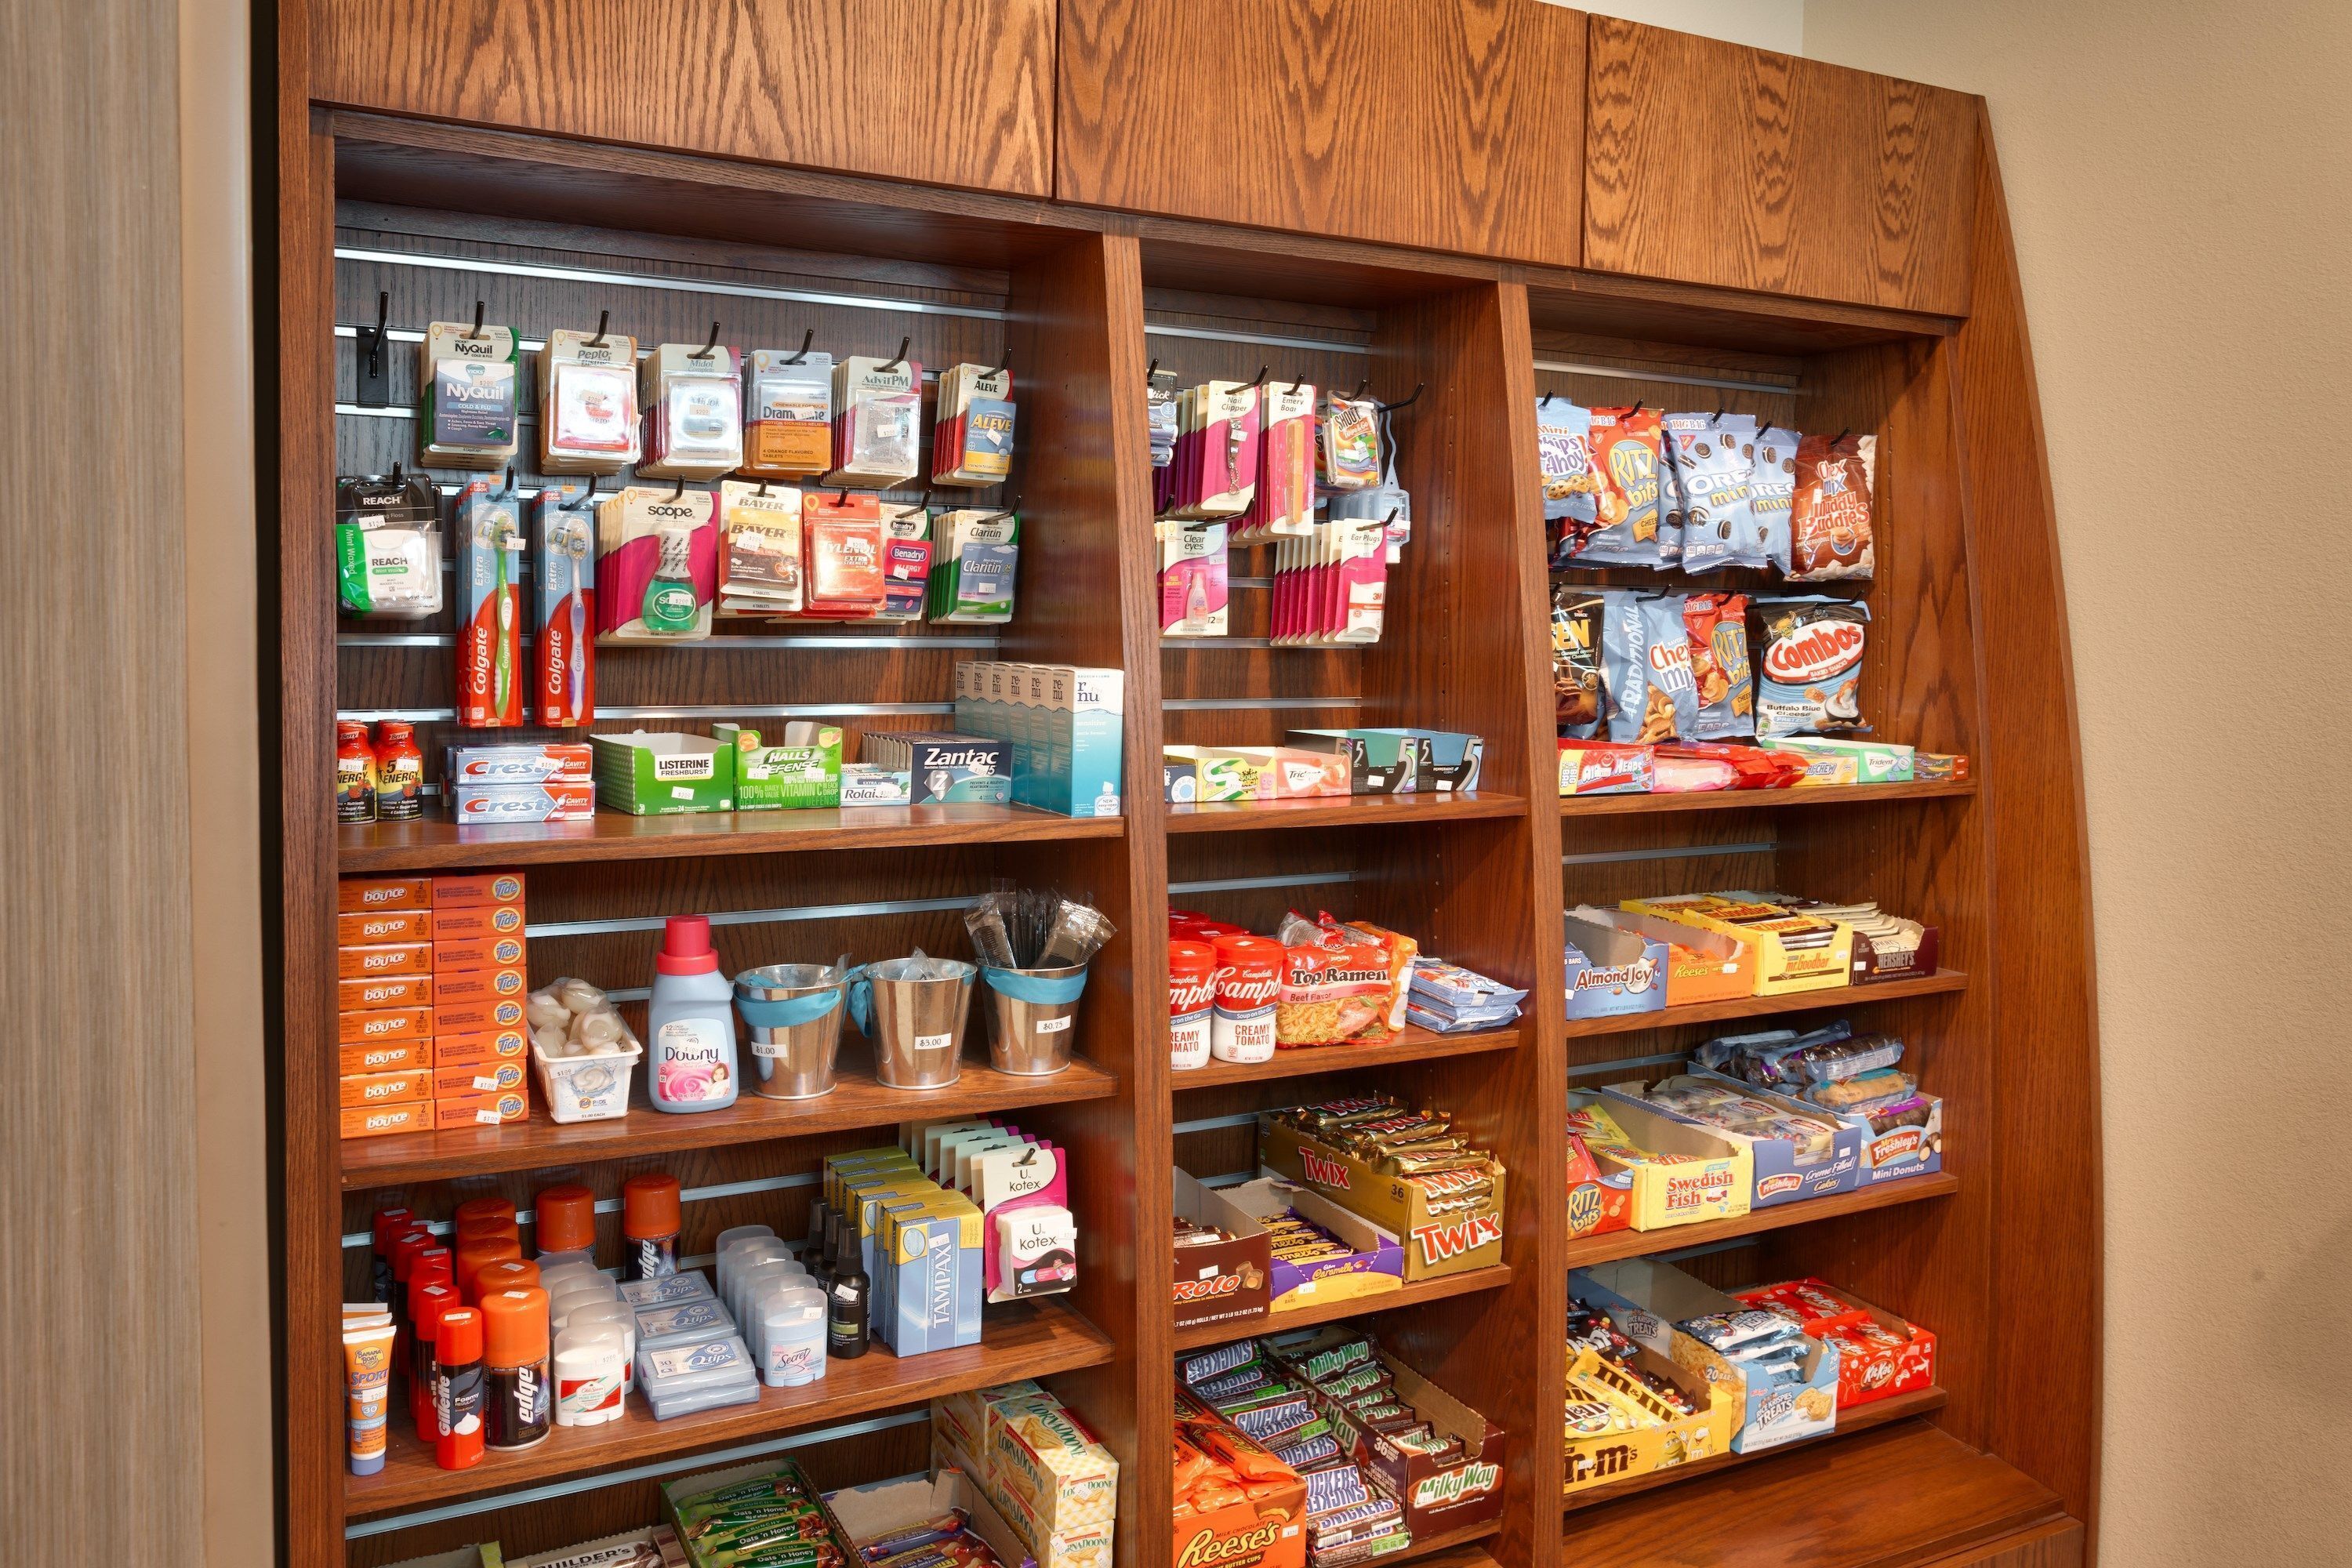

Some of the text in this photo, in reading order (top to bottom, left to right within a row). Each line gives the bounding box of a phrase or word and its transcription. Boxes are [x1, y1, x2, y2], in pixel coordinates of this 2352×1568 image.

[455, 343, 492, 355] NyQuil
[690, 359, 713, 368] Midol
[446, 383, 504, 401] NyQuil
[974, 380, 999, 393] ALEVE
[970, 414, 1012, 433] ALEVE
[1671, 419, 1706, 430] BIG BAG
[1545, 449, 1585, 474] Ahoy
[1611, 449, 1657, 491] RITZ
[1817, 459, 1848, 481] Chex
[1824, 474, 1848, 496] mix
[363, 496, 401, 506] REACH
[1627, 481, 1659, 508] bits
[739, 499, 784, 510] BAYER
[648, 506, 692, 519] scope
[1798, 503, 1870, 541] Buddies
[731, 524, 786, 539] BAYER
[970, 527, 1001, 538] Claritin
[1183, 535, 1205, 543] Clear
[1363, 535, 1381, 543] Plugs
[345, 529, 358, 575] Mint Waxed
[894, 548, 925, 560] Benadryl
[1184, 543, 1204, 552] eyes
[372, 557, 408, 566] REACH
[963, 560, 1001, 574] Claritin
[474, 555, 484, 586] Extra
[548, 561, 557, 591] Extra
[1771, 625, 1862, 671] Combos
[473, 626, 488, 695] Colgate
[548, 628, 562, 695] Colgate
[1077, 691, 1099, 702] nu
[768, 750, 811, 764] HALLS
[924, 747, 1000, 766] Zantac
[659, 759, 710, 770] LISTERINE
[1392, 737, 1415, 794] 5
[1456, 737, 1483, 792] 5
[1806, 763, 1838, 776] HI-CHEW
[384, 771, 419, 784] ENERGY
[661, 768, 708, 777] FRESHBURST
[739, 785, 764, 800] 100%
[781, 782, 822, 798] VITAMIN C
[464, 798, 556, 813] Crest
[810, 795, 839, 806] DEFENSE
[363, 887, 406, 902] bounce
[495, 884, 519, 897] Tide
[363, 920, 406, 935] bounce
[495, 913, 518, 927] Tide
[363, 953, 406, 967] bounce
[495, 946, 519, 959] Tide
[1878, 950, 1916, 969] HERSHEY'S
[1293, 967, 1388, 985] Top Ramen
[1575, 967, 1652, 989] Almond Joy
[1674, 964, 1709, 979] Reese's
[496, 976, 519, 989] Tide
[364, 985, 407, 1000] bounce
[1310, 992, 1332, 1001] Flavor
[497, 1007, 520, 1021] Tide
[364, 1018, 407, 1033] bounce
[1042, 1020, 1064, 1031] $0.75
[1235, 1024, 1270, 1036] CREAMY
[497, 1037, 520, 1051] Tide
[919, 1037, 942, 1048] $3.00
[1235, 1034, 1270, 1047] TOMATO
[365, 1050, 407, 1064] bounce
[665, 1047, 720, 1068] Downy
[756, 1046, 776, 1055] $1.00
[497, 1069, 520, 1083] Tide
[365, 1082, 407, 1097] bounce
[499, 1098, 523, 1114] Tide
[366, 1112, 408, 1128] bounce
[1873, 1134, 1919, 1159] Freshley's
[1805, 1155, 1857, 1181] Creme Filled
[1871, 1163, 1925, 1181] Mini Donuts
[1666, 1171, 1735, 1192] Swedish
[1762, 1177, 1798, 1192] Freshley's
[1813, 1178, 1841, 1192] Cakes
[1390, 1184, 1403, 1198] 36
[1390, 1196, 1403, 1204] COUNT
[1568, 1185, 1602, 1219] RITZ
[1666, 1190, 1703, 1210] Fish
[1570, 1210, 1600, 1230] bits
[1312, 1265, 1354, 1280] Caramello
[933, 1244, 953, 1330] TAMPAX
[1017, 1283, 1022, 1294] 2
[675, 1313, 714, 1327] Q-tips
[1627, 1322, 1657, 1337] TREATS
[358, 1348, 382, 1359] BANANA
[361, 1356, 378, 1365] BOAT
[690, 1354, 733, 1367] Q-tips
[778, 1348, 811, 1368] Secret
[1308, 1341, 1369, 1380] Milky Way
[1186, 1341, 1252, 1382] SNICKERS
[351, 1368, 389, 1386] SPORT
[1706, 1367, 1734, 1381] 20 BARS
[454, 1392, 480, 1403] Foamy
[514, 1366, 539, 1424] edge
[364, 1405, 378, 1414] 30
[438, 1375, 451, 1436] Gillette
[1756, 1392, 1794, 1417] RICE KRISPIES
[1756, 1399, 1794, 1431] TREATS
[1373, 1437, 1388, 1456] 36
[1087, 1480, 1113, 1490] DOONE
[1414, 1470, 1465, 1508] Milky
[1463, 1462, 1499, 1492] Way
[1232, 1520, 1265, 1533] CHOCOLATE
[1083, 1537, 1109, 1547] DOONE
[1178, 1523, 1281, 1568] Reese's
